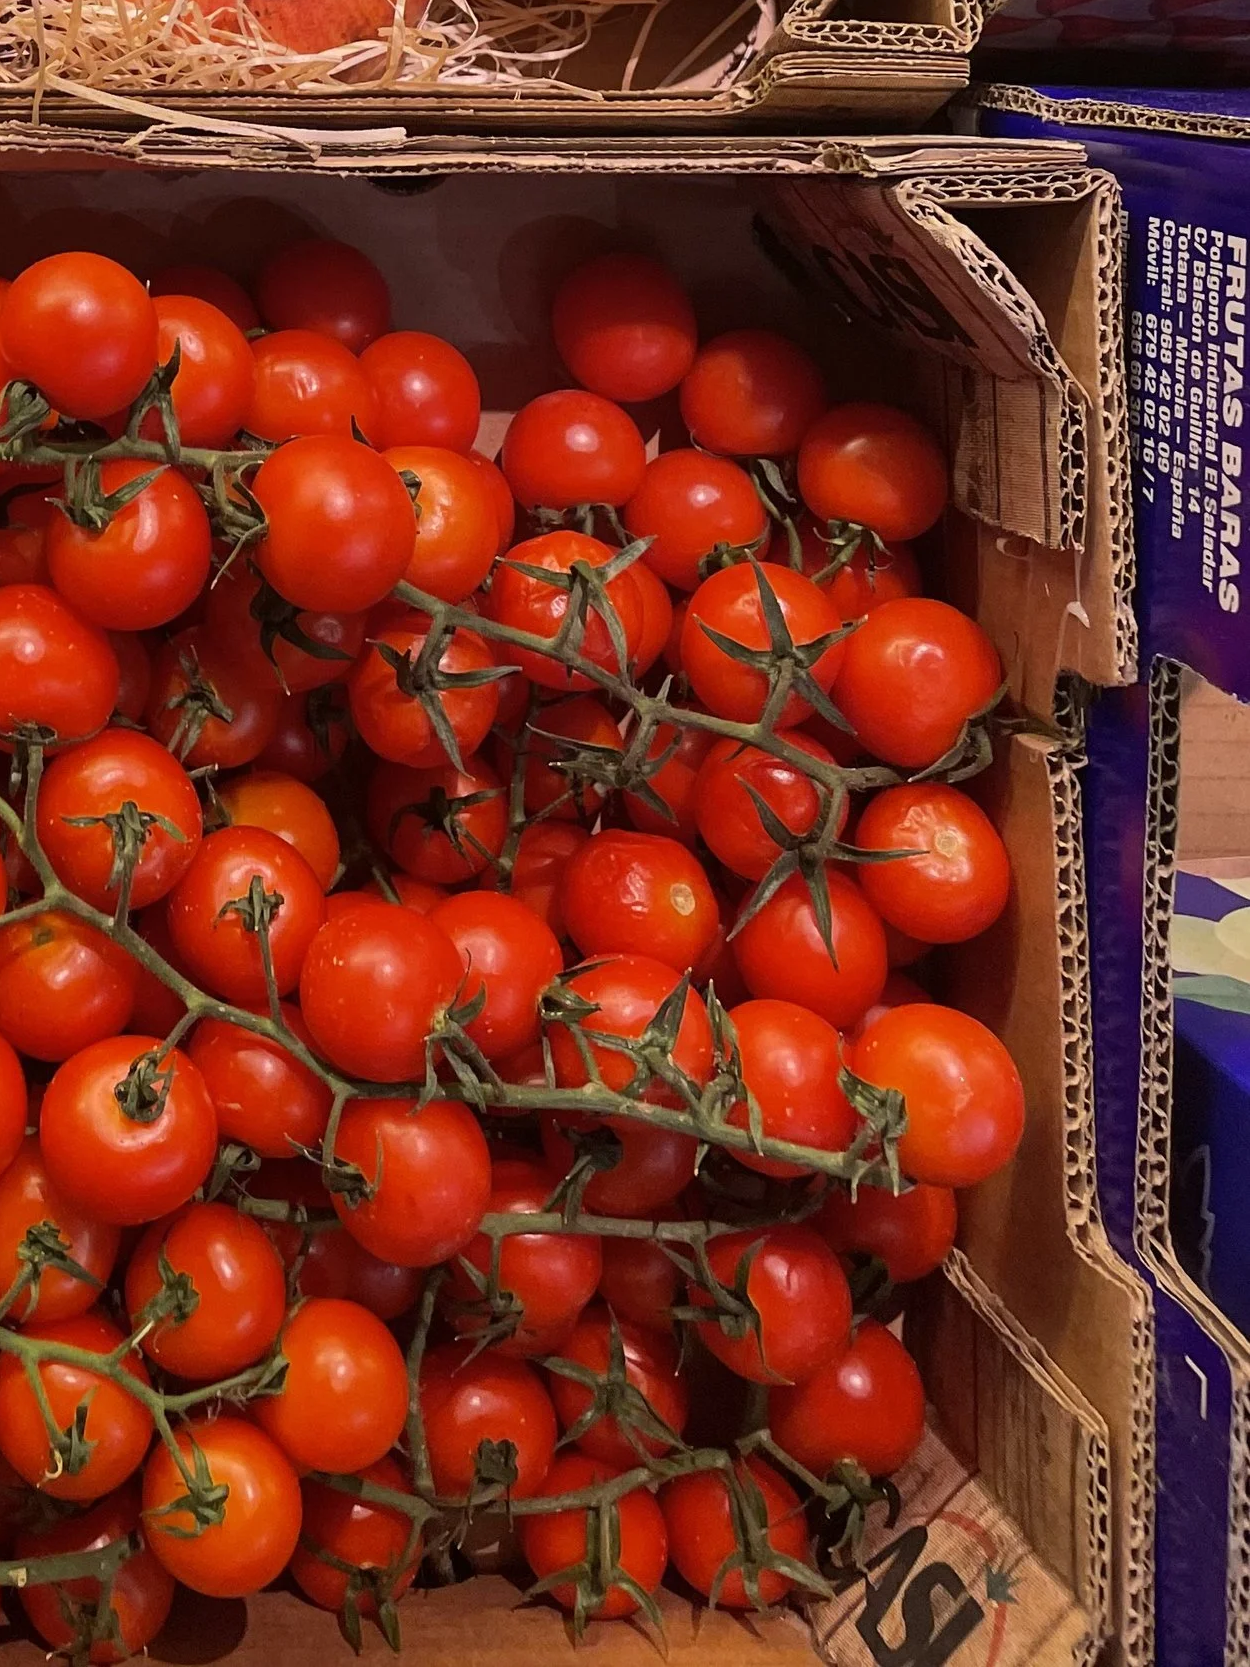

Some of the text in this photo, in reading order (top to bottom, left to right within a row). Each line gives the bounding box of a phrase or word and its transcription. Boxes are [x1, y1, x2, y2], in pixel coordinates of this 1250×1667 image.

[1146, 216, 1161, 287] Móvil:
[1176, 223, 1192, 305] Totana
[1130, 310, 1143, 356] 636
[1144, 313, 1157, 359] 679
[1157, 219, 1176, 474] Central: 968 42 02 09
[1129, 360, 1142, 391] 60
[1144, 362, 1156, 395] 42
[1174, 335, 1188, 421] Murcia
[1187, 226, 1207, 515] C/ Balsón de Guillén 14
[1129, 395, 1141, 427] 30
[1143, 398, 1156, 430] 02
[1202, 229, 1224, 594] Polígono industrial El Saladar
[1217, 235, 1247, 614] FRUTAS BARAS
[1142, 436, 1155, 465] 16
[1141, 486, 1154, 504] 7
[1170, 450, 1186, 540] España
